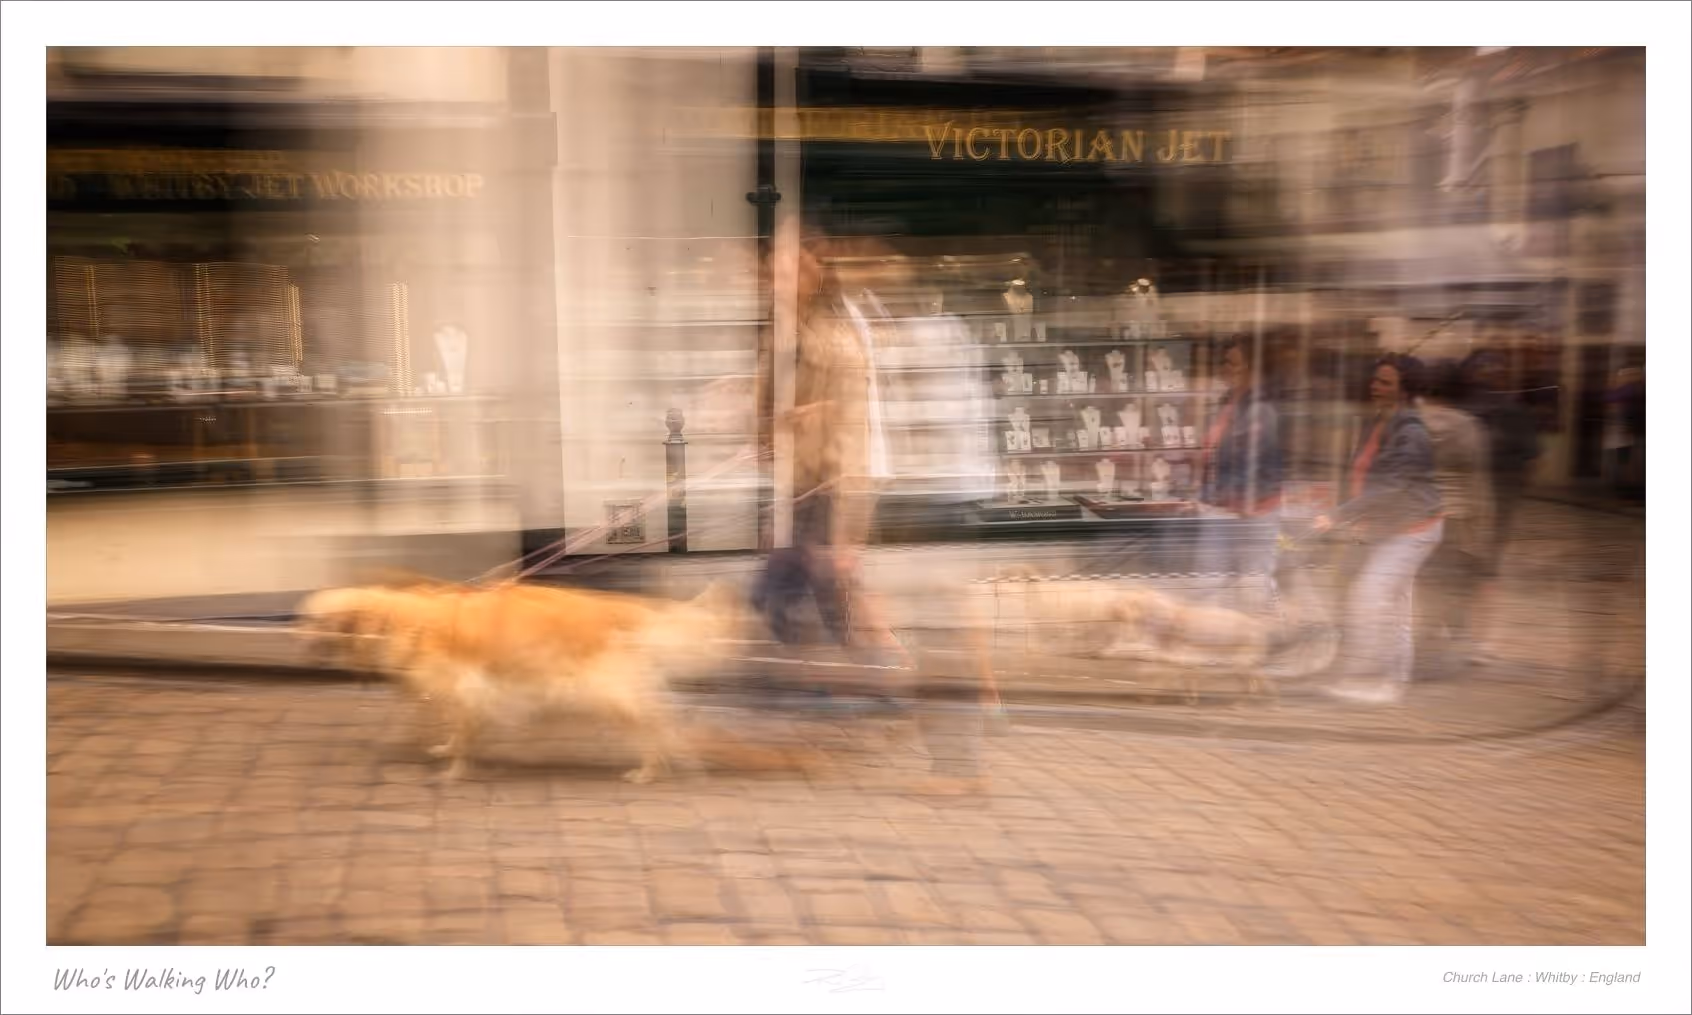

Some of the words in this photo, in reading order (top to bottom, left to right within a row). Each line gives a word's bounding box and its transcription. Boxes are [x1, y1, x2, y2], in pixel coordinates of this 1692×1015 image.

[923, 120, 1144, 164] VICTORIAN
[1157, 128, 1233, 162] JET
[312, 171, 485, 200] WORKSHOP
